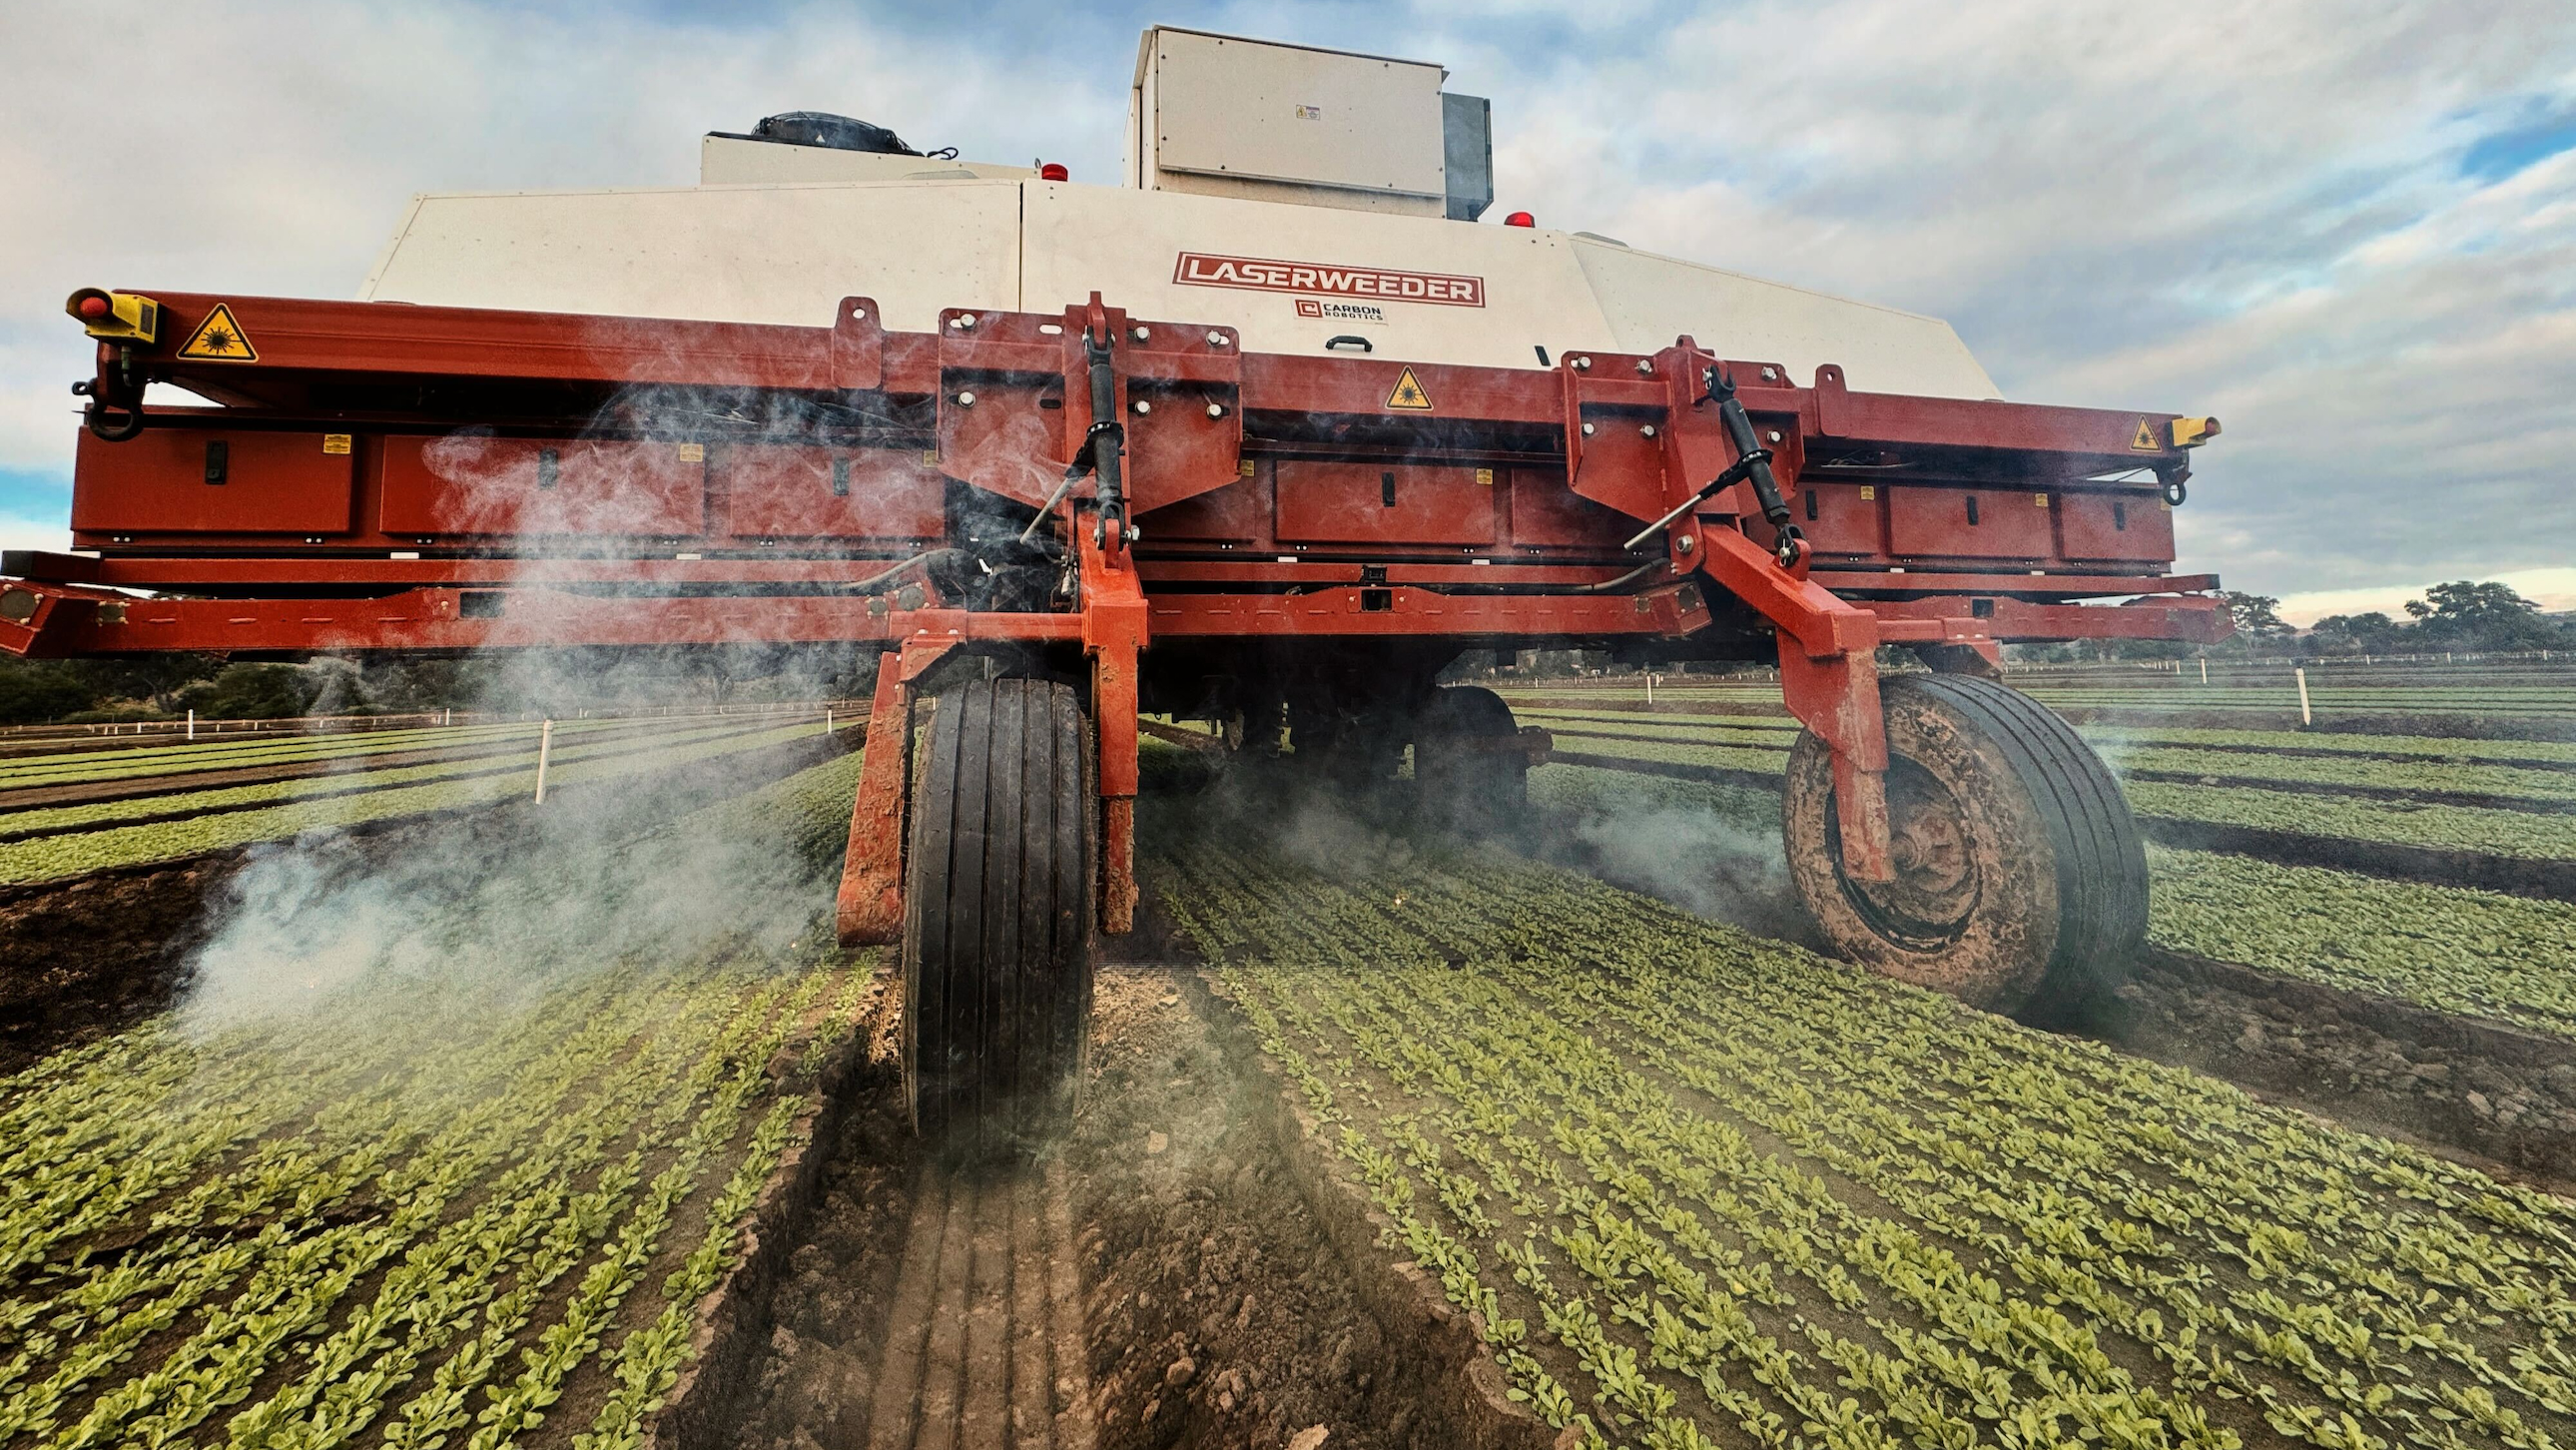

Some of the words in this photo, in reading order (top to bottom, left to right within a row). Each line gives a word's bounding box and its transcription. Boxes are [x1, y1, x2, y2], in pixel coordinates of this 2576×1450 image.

[1188, 260, 1473, 300] LASERWEEDER
[1323, 304, 1381, 315] CARBON
[1325, 312, 1383, 321] ROBOTICS
